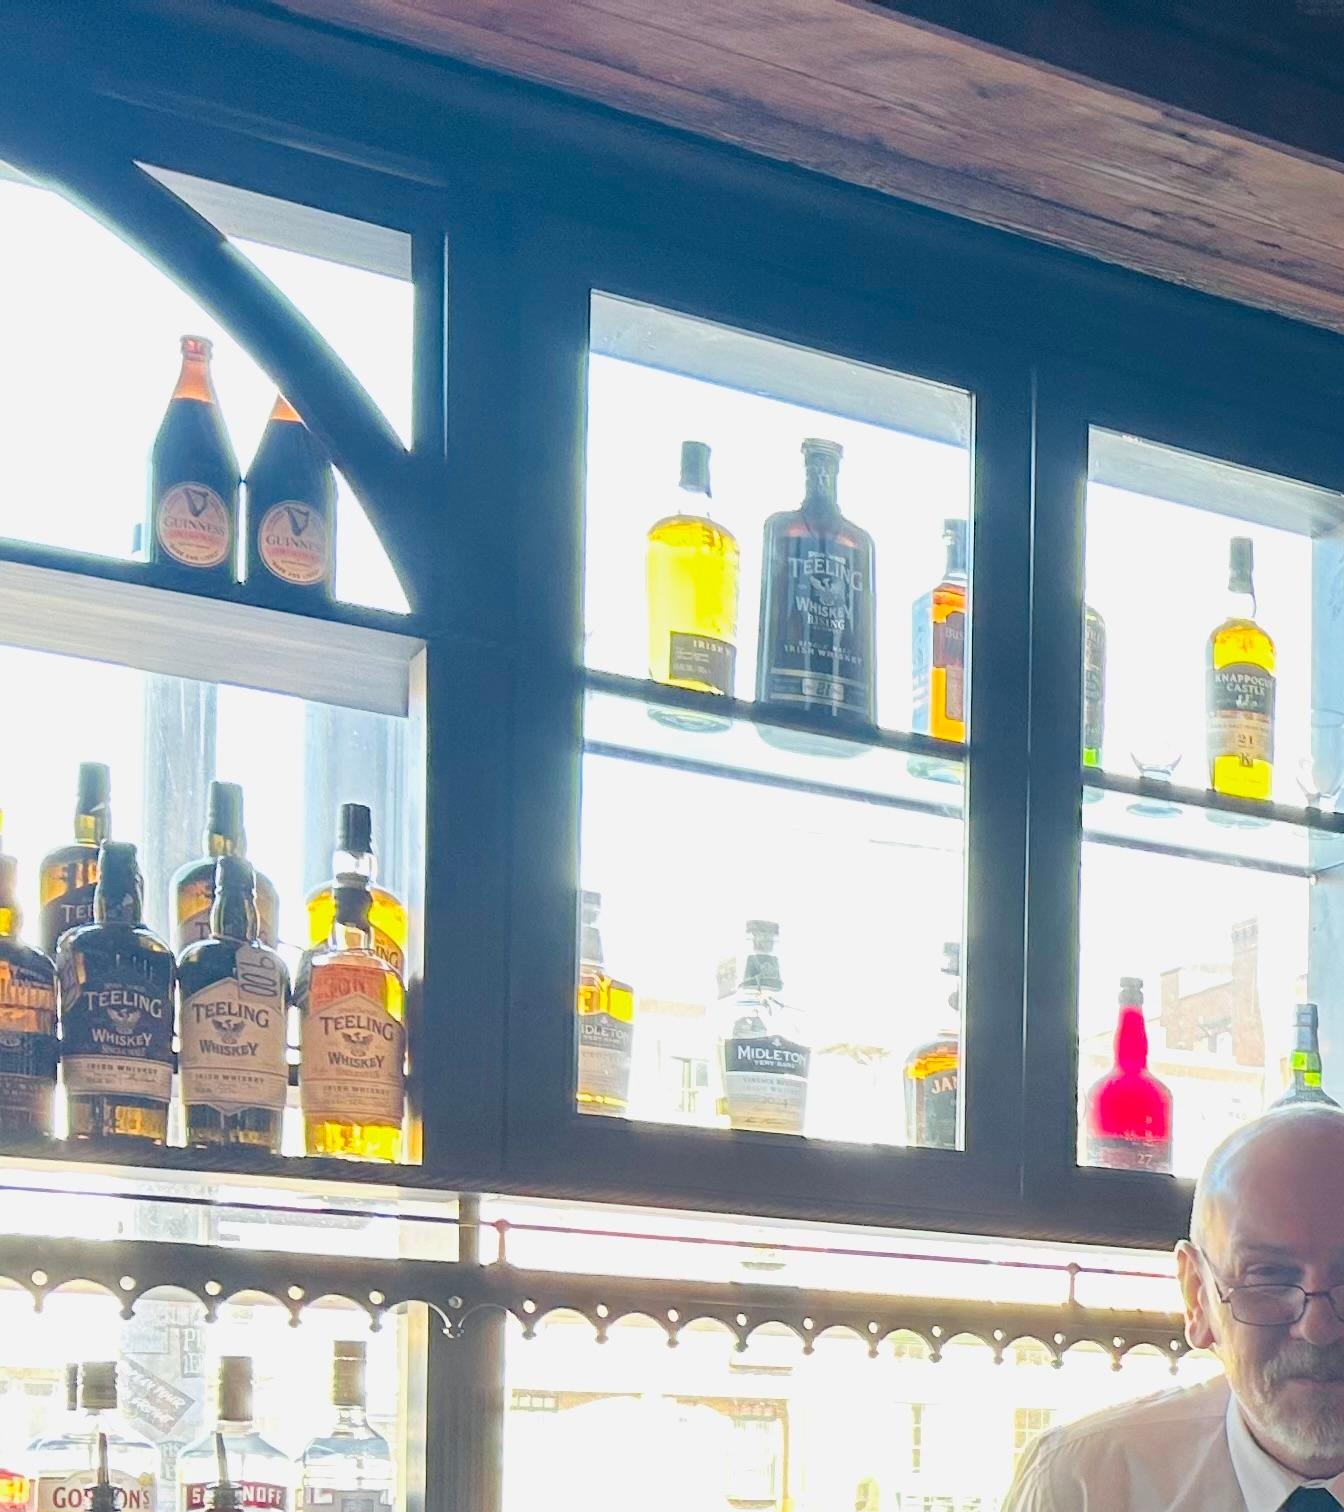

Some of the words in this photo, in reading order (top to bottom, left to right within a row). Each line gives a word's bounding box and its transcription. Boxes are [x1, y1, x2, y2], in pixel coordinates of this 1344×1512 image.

[163, 516, 226, 536] GUINNESS
[789, 556, 863, 591] TEELING
[796, 596, 852, 620] WHISKEY
[86, 990, 163, 1018] TEELING
[192, 1002, 270, 1028] TEELING
[91, 1028, 153, 1048] WHISKEY
[319, 1015, 395, 1041] TEELING
[581, 1024, 632, 1041] IDLETON
[199, 1039, 259, 1057] WHISKEY
[737, 1045, 807, 1066] MIDLETON
[327, 1051, 386, 1070] WHISKEY
[53, 1486, 150, 1509] GOON'S
[192, 1486, 283, 1505] SNOFF
